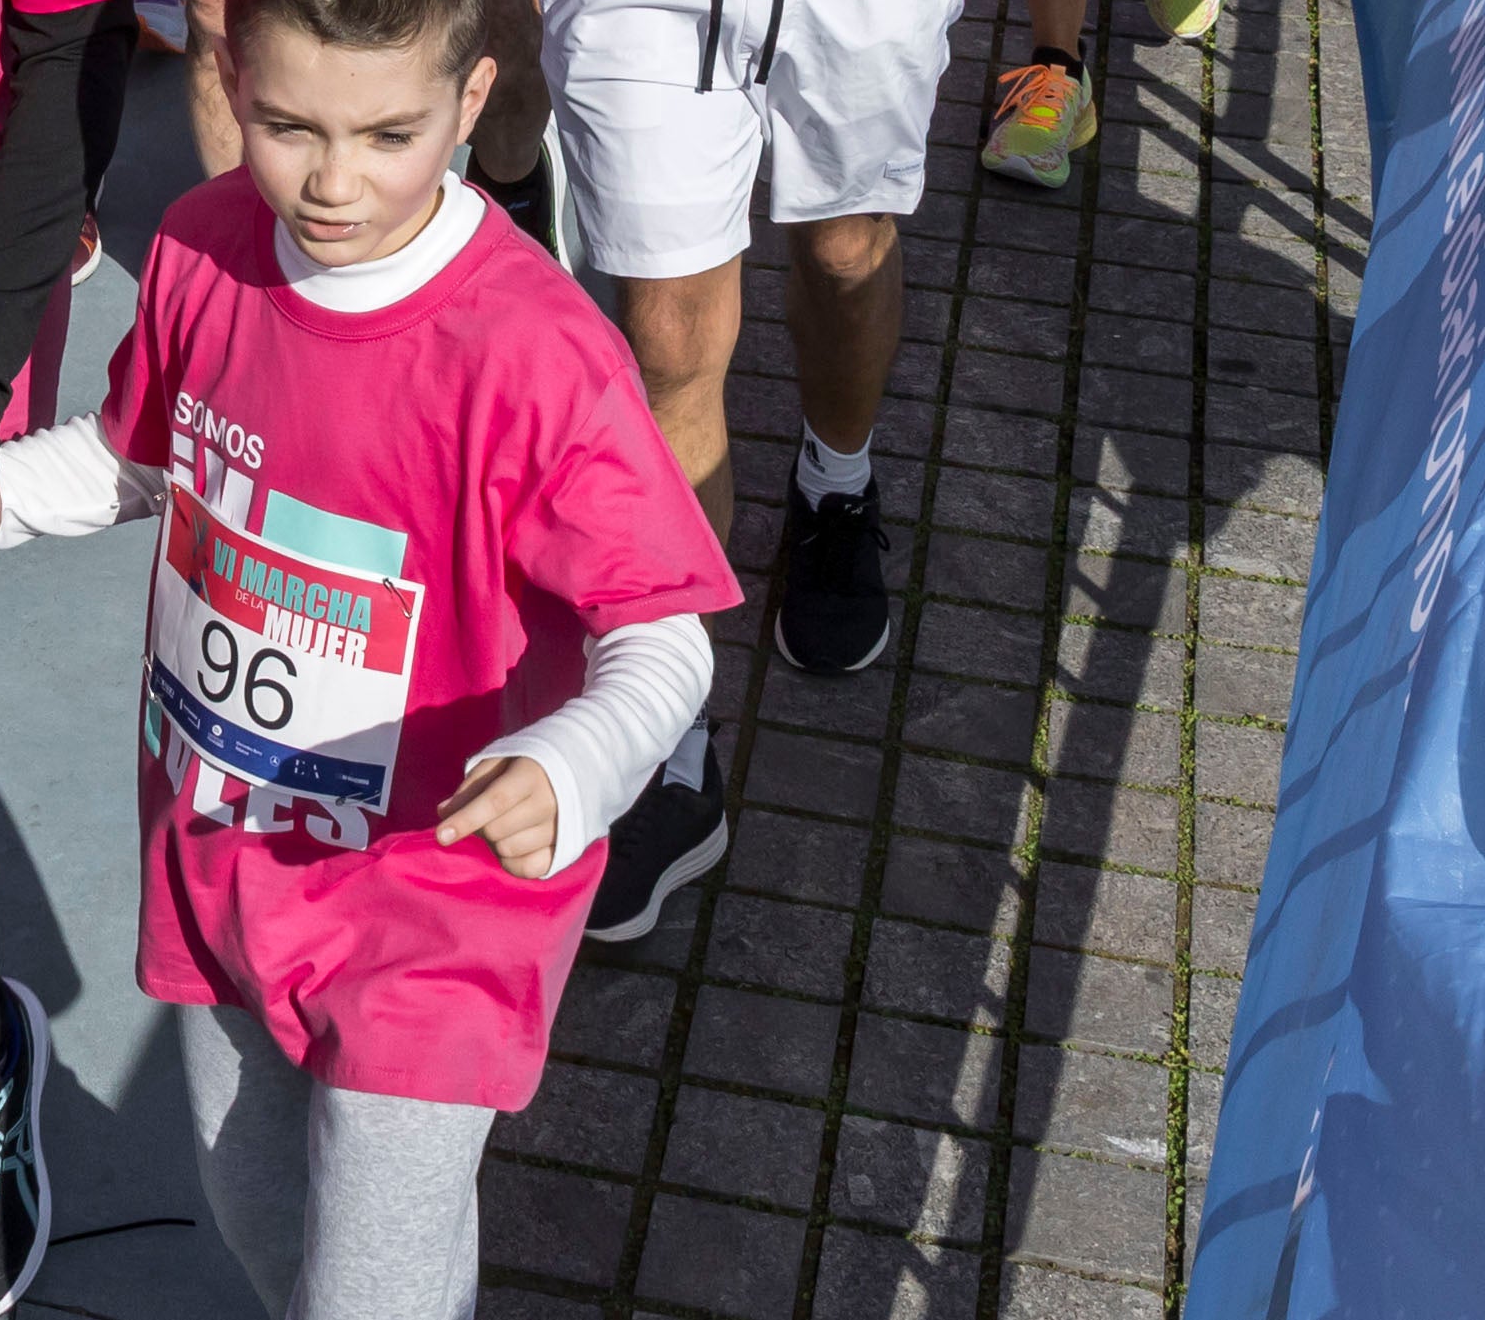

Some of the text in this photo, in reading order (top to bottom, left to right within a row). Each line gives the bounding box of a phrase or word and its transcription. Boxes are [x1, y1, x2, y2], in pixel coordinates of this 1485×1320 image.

[174, 390, 265, 470] SOMOS
[213, 536, 372, 634] VI MARCHA
[235, 588, 264, 613] DE LA
[196, 618, 298, 730] 96
[263, 604, 367, 668] MUJER
